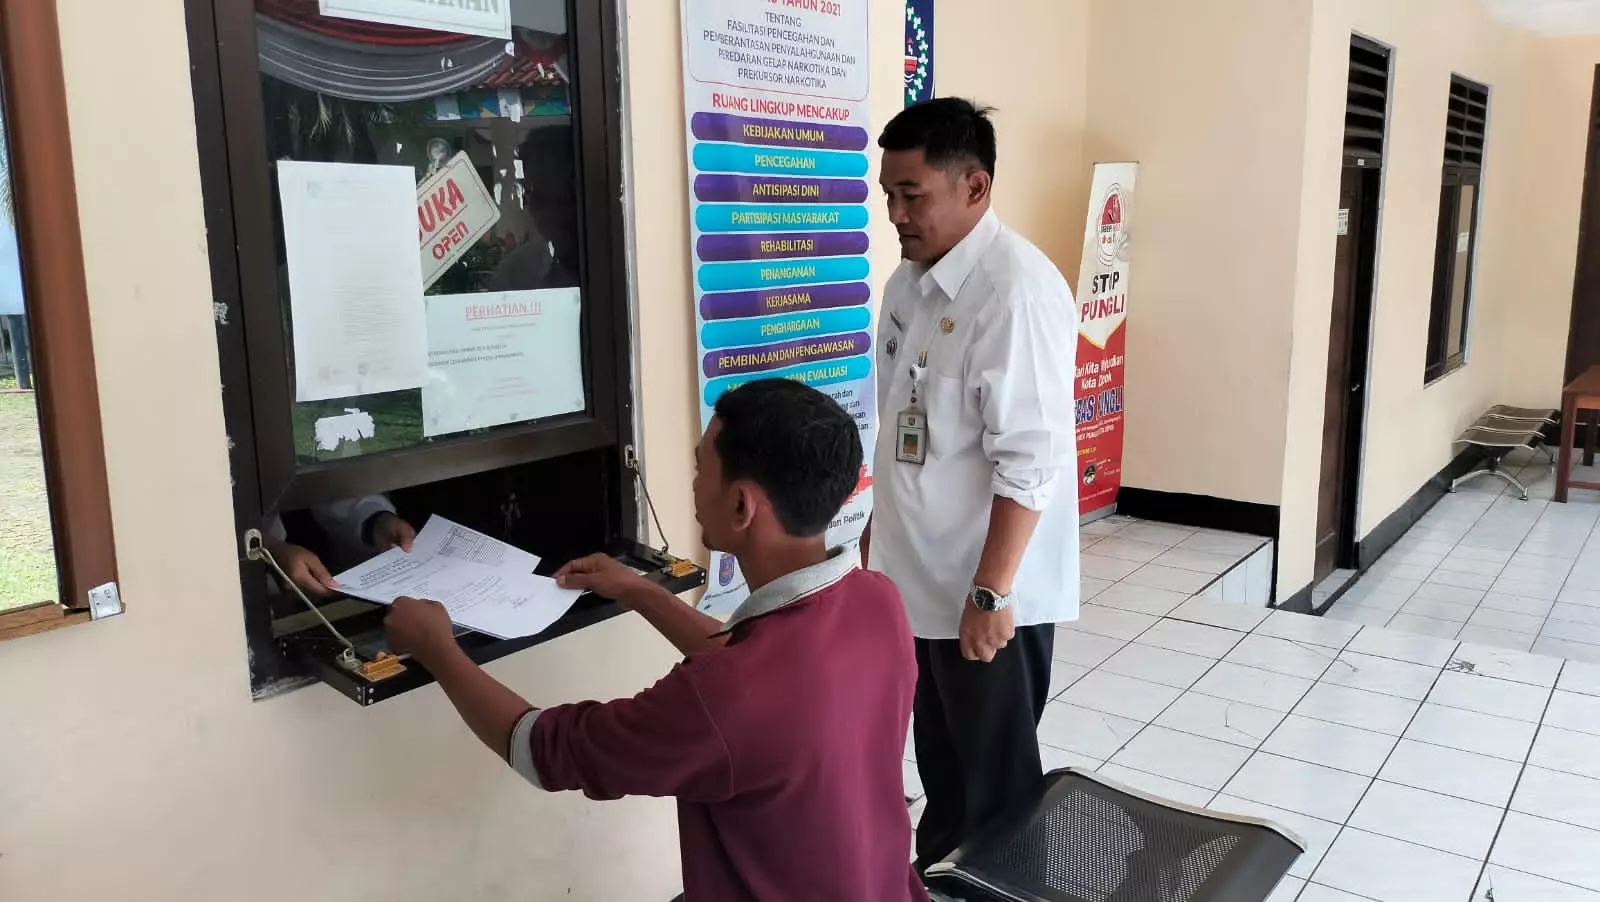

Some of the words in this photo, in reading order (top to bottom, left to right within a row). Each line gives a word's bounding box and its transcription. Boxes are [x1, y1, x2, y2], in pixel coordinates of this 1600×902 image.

[820, 0, 841, 17] 2021
[765, 12, 802, 27] TENTANG
[727, 19, 766, 36] FASILITASI
[767, 27, 820, 45] PENCEGAHAN
[820, 37, 835, 48] DAN
[703, 30, 771, 52] PEMBERANTASAN
[771, 43, 841, 63] PENYALAHGUNAAN
[841, 54, 856, 65] DAN
[718, 48, 762, 65] PEREDARAN
[763, 57, 787, 69] GELAP
[787, 61, 831, 76] NARKOTIKA
[831, 67, 846, 78] DAN
[738, 68, 783, 83] PREKURSOR
[784, 75, 827, 89] NARKOTIKA
[712, 93, 748, 112] RUANG
[750, 98, 795, 117] LINGKUP
[796, 105, 850, 121] MENCAKUP
[743, 124, 795, 141] KEBIJAKAN
[796, 129, 825, 142] UMUM
[754, 154, 816, 169] PENCEGAHAN
[752, 183, 800, 197] ANTISIPASI
[801, 184, 820, 197] DINI
[418, 178, 465, 242] UKA
[731, 211, 781, 225] PARTISIPASI
[782, 211, 840, 224] MASYARAKAT
[432, 221, 469, 260] OPEN
[760, 239, 814, 252] REHABILITASI
[760, 266, 816, 281] PENANGANAN
[766, 292, 811, 309] KERJASAMA
[1080, 293, 1125, 323] PUNGLI
[465, 303, 527, 318] PERHATIAN
[761, 319, 820, 337] PENGHARGAAN
[718, 352, 781, 369] PEMBINAAN
[780, 349, 795, 361] DAN
[795, 339, 855, 358] PENGAWASAN
[807, 365, 849, 383] EVALUASI
[1084, 361, 1099, 376] Kita
[1081, 377, 1097, 389] Kota
